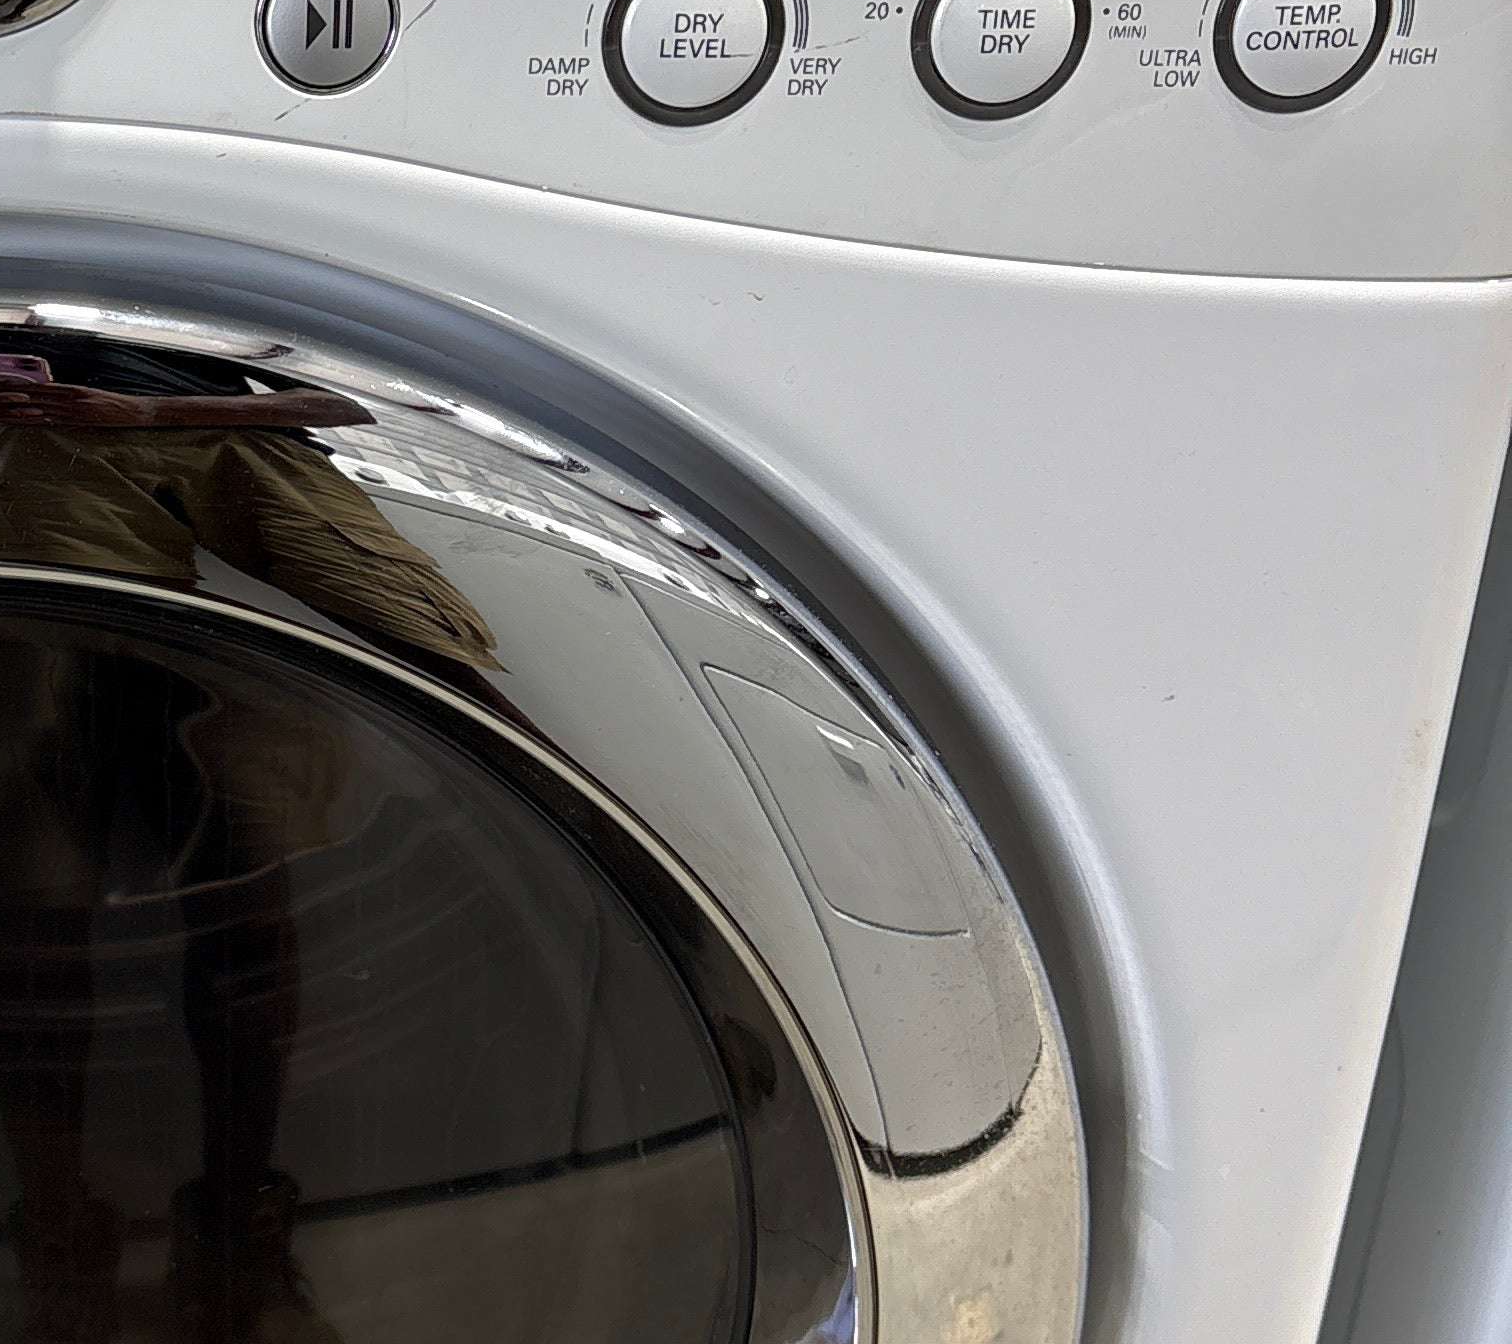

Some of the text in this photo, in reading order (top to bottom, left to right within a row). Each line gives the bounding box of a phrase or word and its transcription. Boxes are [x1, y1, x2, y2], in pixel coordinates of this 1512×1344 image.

[865, 2, 889, 20] 20
[978, 9, 1036, 29] TIME
[1118, 4, 1141, 21] 60
[1275, 4, 1343, 29] TEMP.
[675, 14, 724, 33] DRY
[1109, 26, 1146, 40] (MIN)
[1246, 28, 1358, 51] CONTROL
[658, 38, 734, 59] LEVEL
[981, 34, 1030, 54] DRY
[1139, 50, 1202, 68] ULTRA
[1389, 48, 1437, 65] HIGH
[529, 58, 590, 74] DAMP
[790, 58, 841, 74] VERY
[788, 79, 828, 95] DRY
[1154, 70, 1200, 87] LOW
[547, 79, 589, 96] DRY
